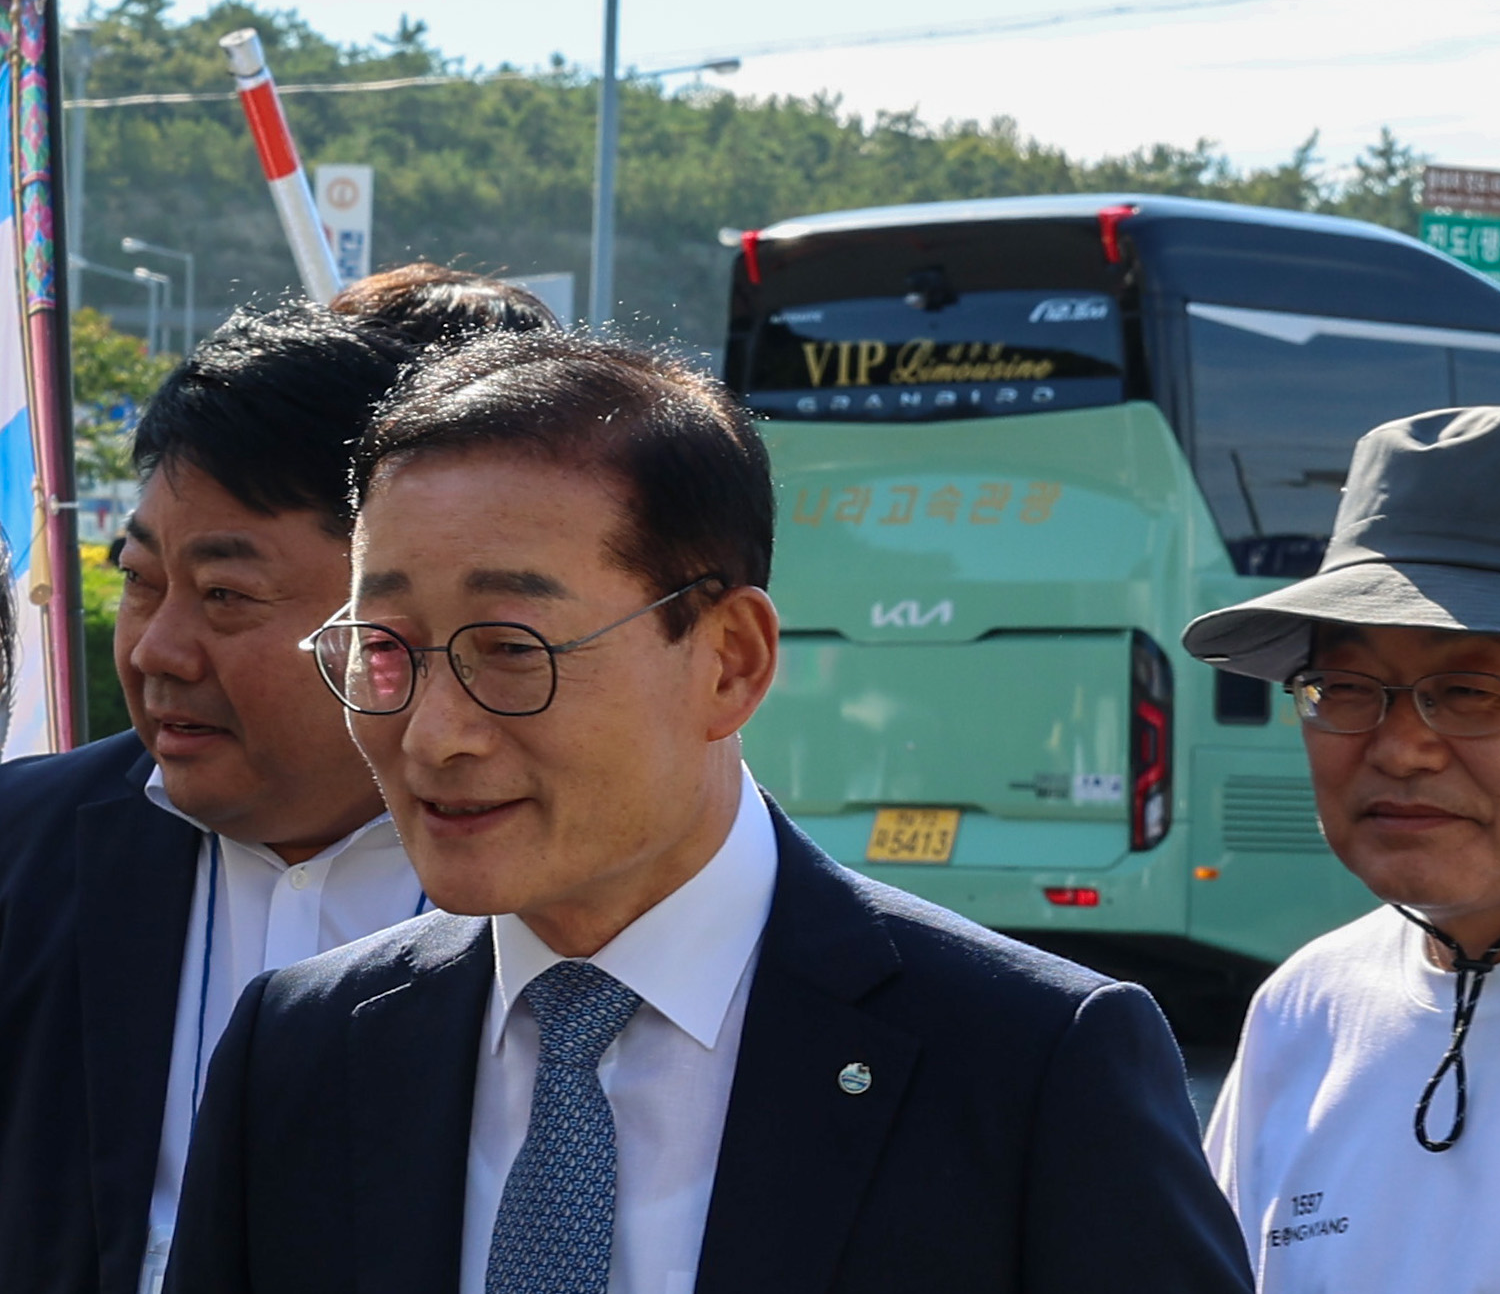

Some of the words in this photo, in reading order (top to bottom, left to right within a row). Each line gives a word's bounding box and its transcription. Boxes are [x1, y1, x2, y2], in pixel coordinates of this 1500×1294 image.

[802, 339, 888, 388] VIP
[796, 386, 1055, 413] GRANBIRD
[870, 599, 955, 629] KIA
